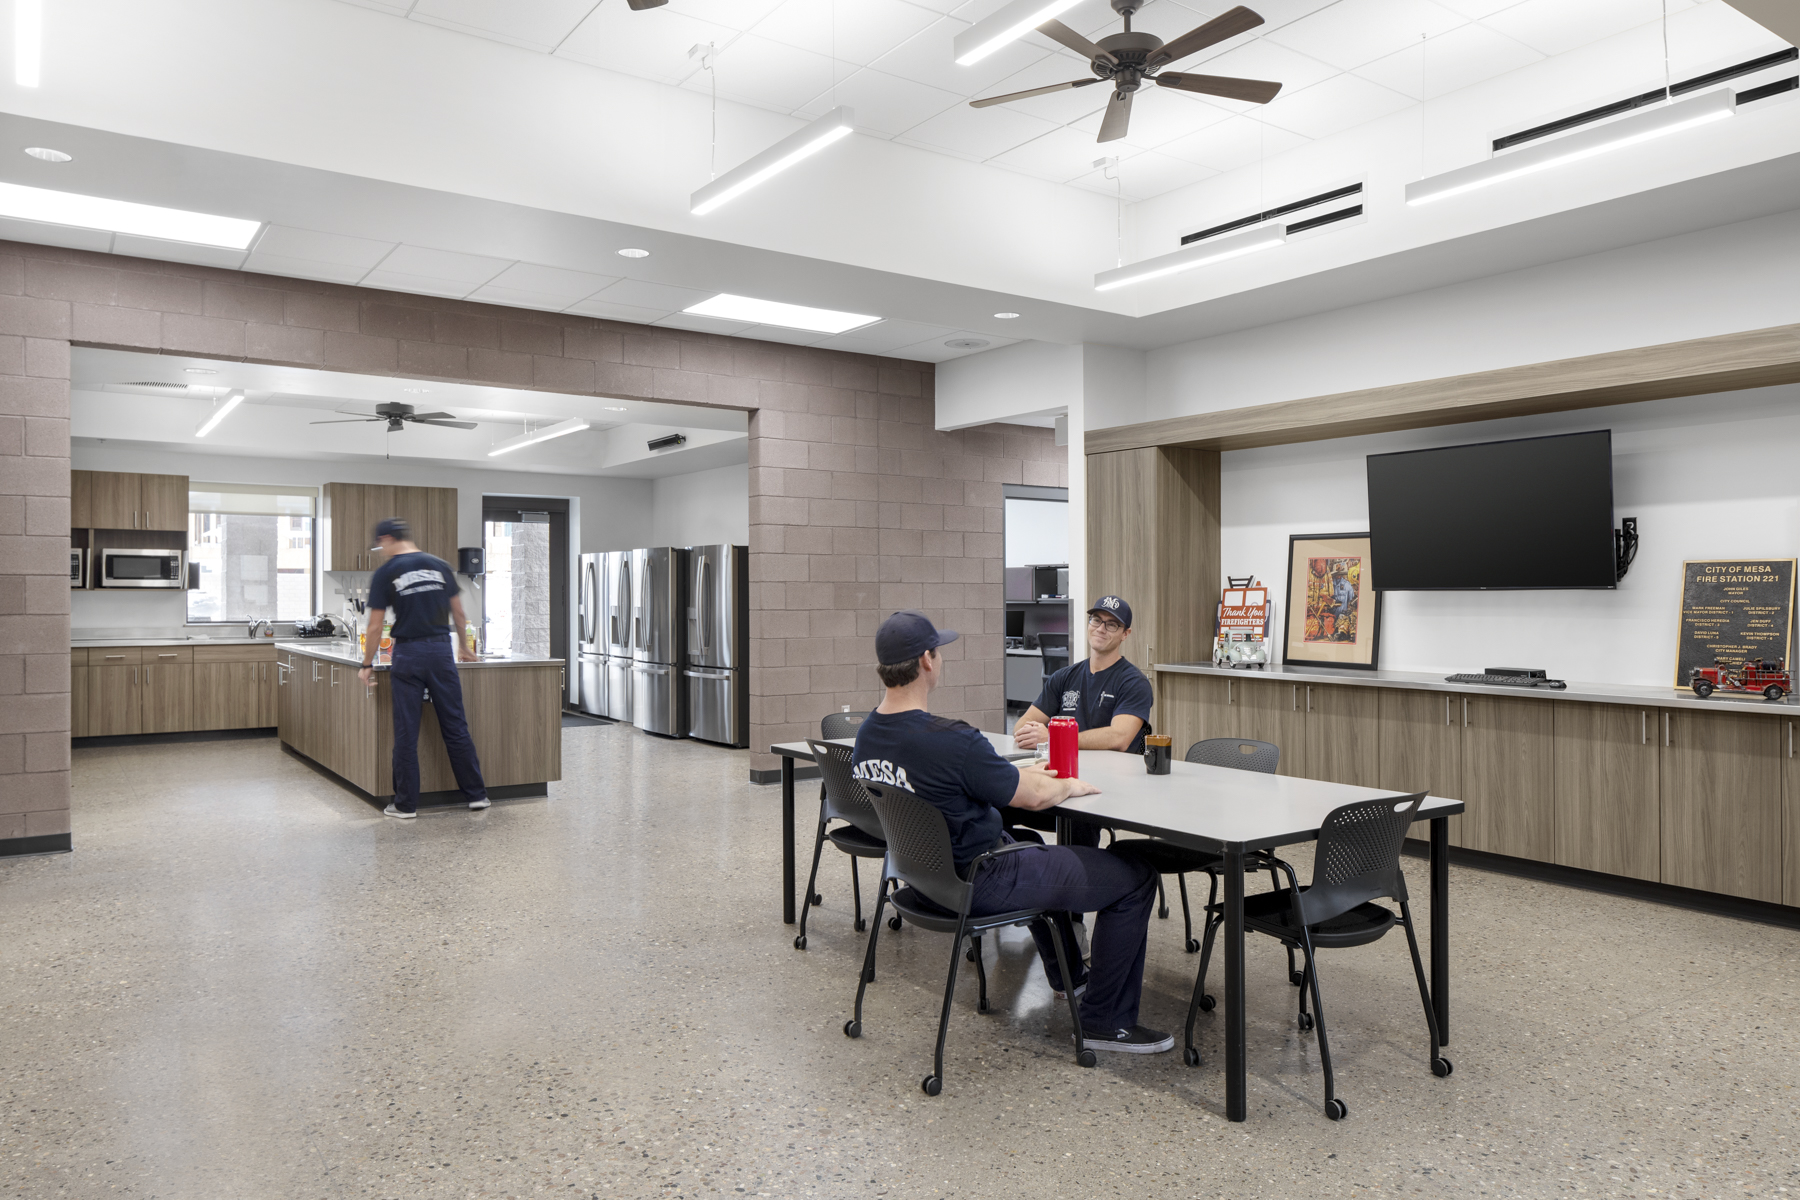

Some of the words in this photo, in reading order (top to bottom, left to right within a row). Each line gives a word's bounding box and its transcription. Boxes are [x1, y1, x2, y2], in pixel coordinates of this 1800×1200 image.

[1223, 607, 1246, 617] Thank
[1247, 607, 1264, 618] You
[853, 758, 916, 794] MESA
